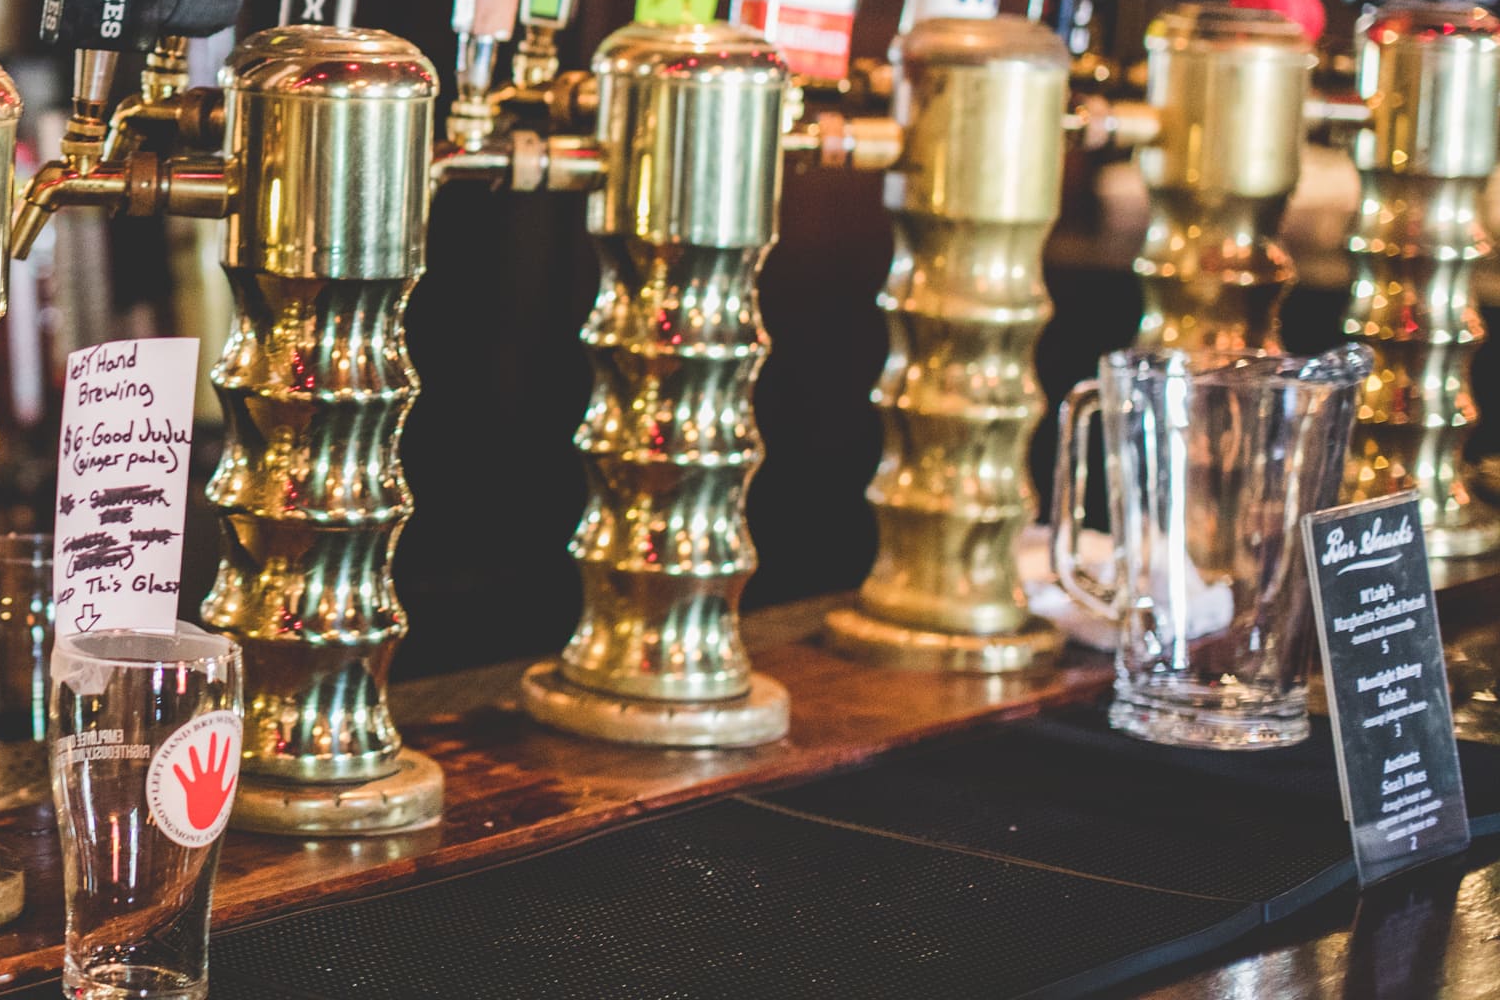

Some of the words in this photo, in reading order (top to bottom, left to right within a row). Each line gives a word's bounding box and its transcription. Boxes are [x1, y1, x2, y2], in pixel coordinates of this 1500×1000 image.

[97, 343, 138, 374] Hand
[78, 380, 155, 408] Brewing
[1322, 526, 1357, 566] Bar
[1359, 515, 1415, 555] Snacks
[85, 574, 122, 595] This
[1381, 639, 1390, 655] 5
[1395, 722, 1403, 738] 3
[151, 763, 165, 795] LEFT
[163, 729, 191, 761] HAND
[1409, 835, 1418, 851] 2
